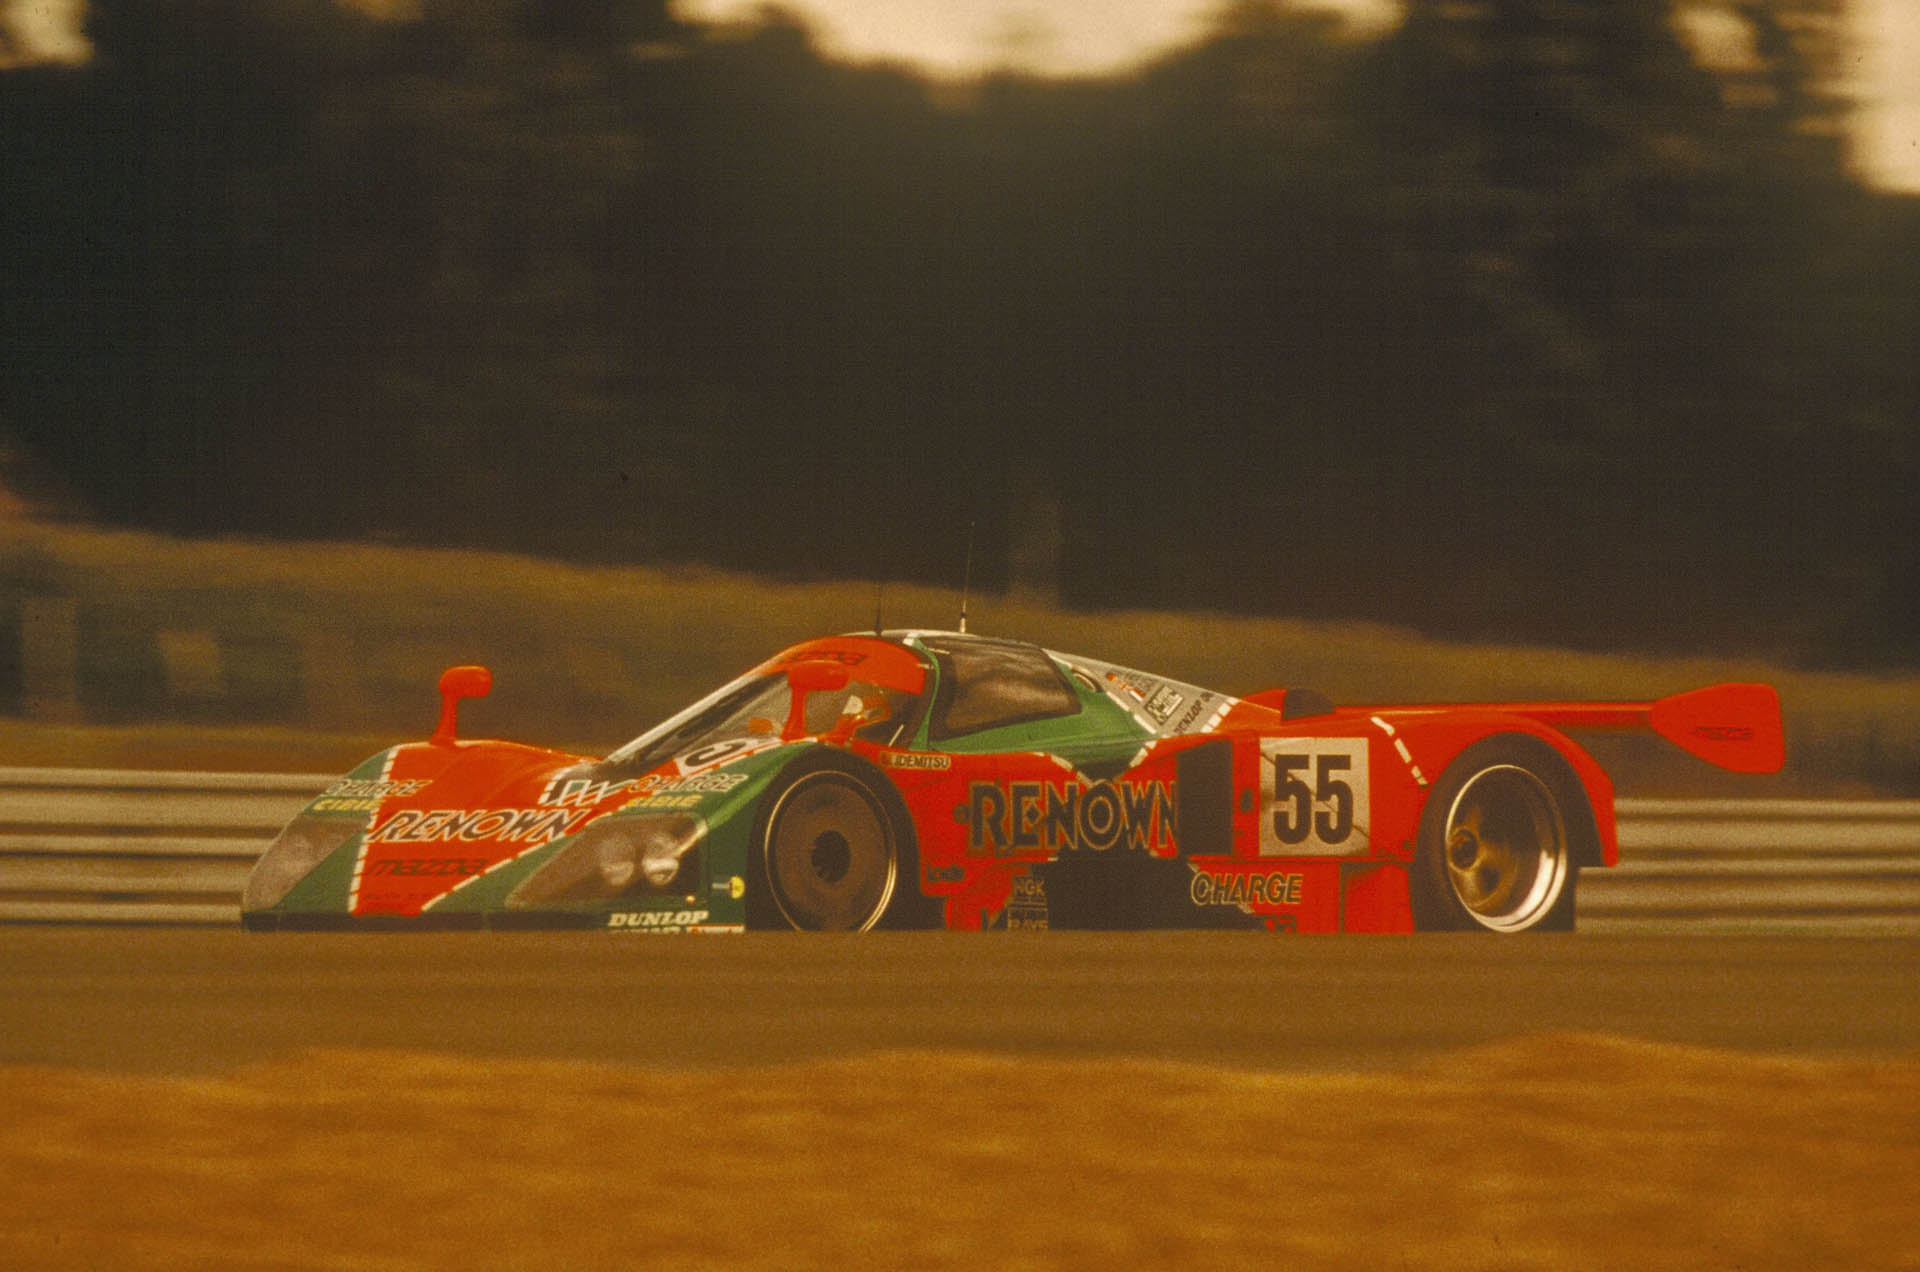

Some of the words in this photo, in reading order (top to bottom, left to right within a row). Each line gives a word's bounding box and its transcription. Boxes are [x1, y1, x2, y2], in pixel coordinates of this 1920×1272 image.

[894, 754, 950, 768] IDEMITSU
[969, 778, 1177, 851] RENOWN
[1273, 754, 1353, 845] 55
[366, 807, 593, 843] RENOWN
[1015, 877, 1046, 896] NGK
[1190, 871, 1303, 906] CHARGE
[608, 909, 710, 928] DUNLOP
